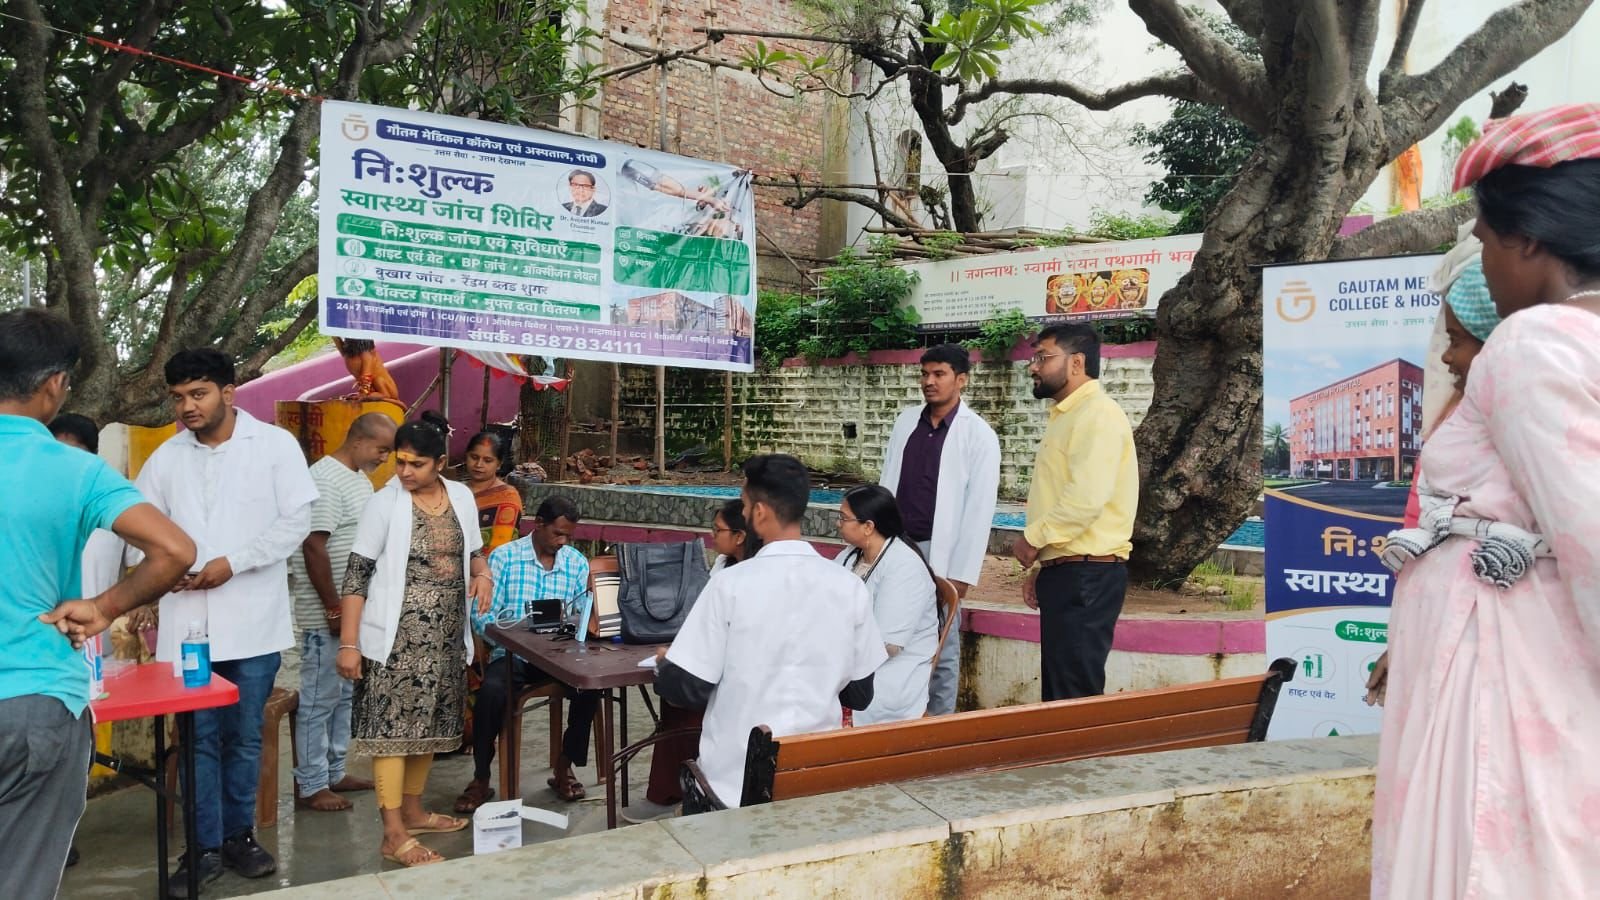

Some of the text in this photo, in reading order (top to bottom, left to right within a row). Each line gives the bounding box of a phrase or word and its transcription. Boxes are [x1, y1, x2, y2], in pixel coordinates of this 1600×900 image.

[386, 123, 419, 139] गौतम
[421, 128, 464, 145] मेडिकल
[466, 135, 503, 151] कॉलेज
[505, 143, 522, 154] एवं
[525, 146, 574, 162] अस्पताल,
[340, 189, 554, 231] स्वास्थ्य जांच शिविर
[448, 230, 481, 247] जांच
[485, 234, 509, 251] एवं
[374, 247, 402, 260] हाइट
[406, 249, 424, 263] एवं
[461, 257, 481, 268] BP
[483, 259, 507, 272] जांच
[1024, 256, 1061, 273] स्वामी
[1067, 257, 1099, 271] नयन
[1105, 249, 1163, 267] पथगामी
[1168, 250, 1198, 263] भव
[375, 267, 412, 281] बुखार
[416, 270, 444, 284] जांच
[492, 280, 518, 292] ब्लड
[521, 283, 549, 296] शुगर
[1338, 276, 1429, 294] GAUTAM ME
[374, 283, 418, 299] डॉक्टर
[516, 301, 538, 313] दवा
[541, 301, 581, 316] वितरण
[1329, 293, 1440, 312] COLLEGE & HOS
[438, 313, 483, 324] ICU/NICU
[629, 331, 647, 339] ECG
[467, 327, 642, 354] संपर्क: 8587834111
[1283, 569, 1389, 597] स्वास्थ्य
[1288, 688, 1308, 698] हाइट
